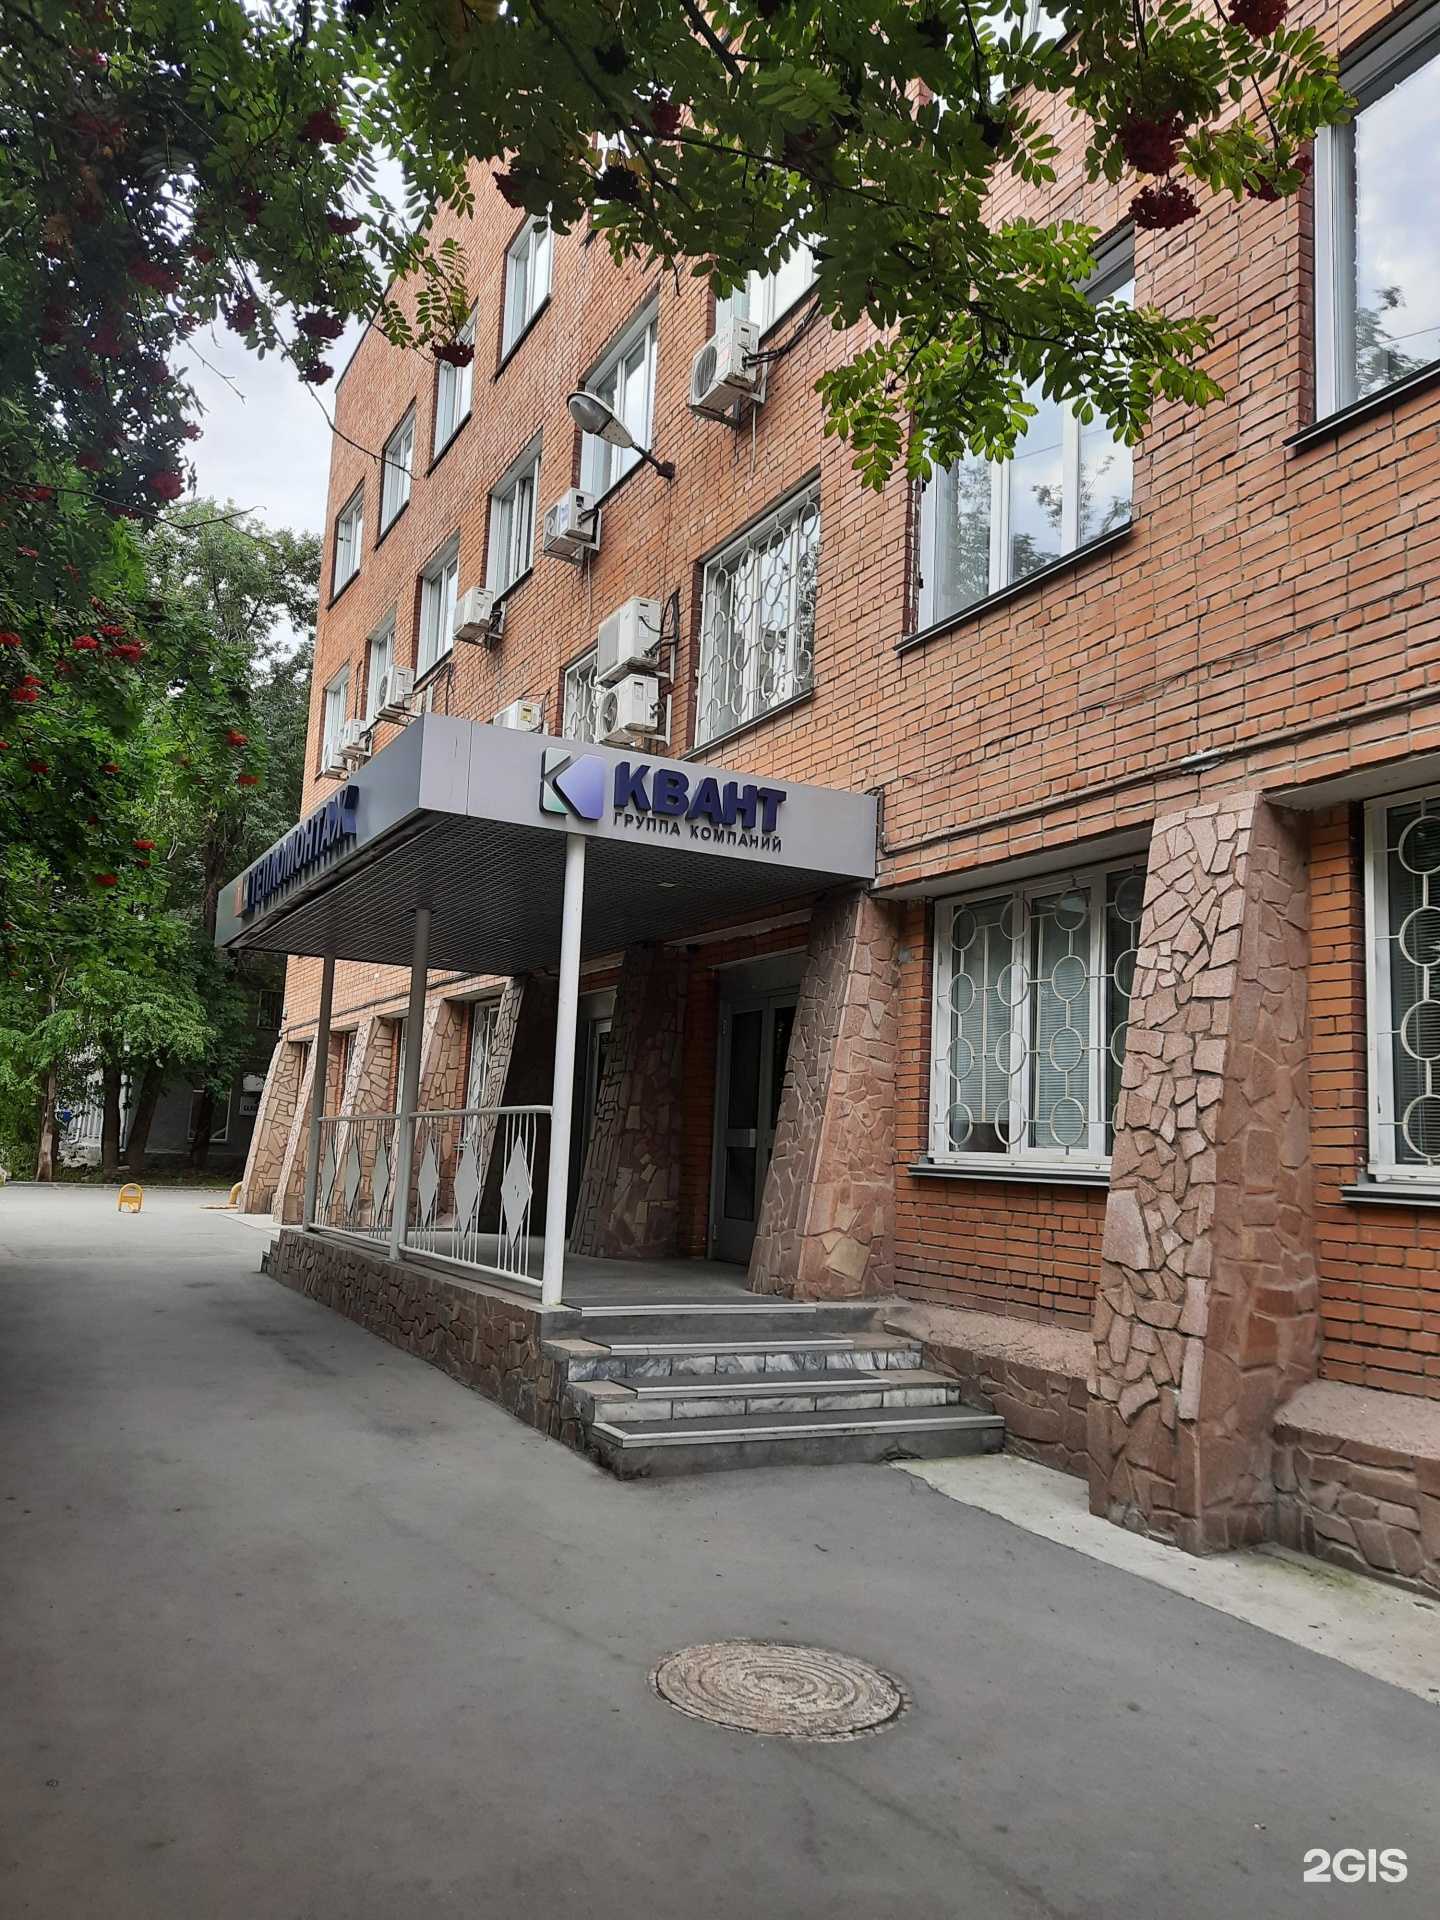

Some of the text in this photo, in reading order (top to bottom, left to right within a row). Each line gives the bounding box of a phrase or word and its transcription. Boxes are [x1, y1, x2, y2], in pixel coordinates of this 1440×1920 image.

[614, 761, 787, 833] КВАНТ
[613, 811, 782, 853] ГРУППА КОМПАНИЙ
